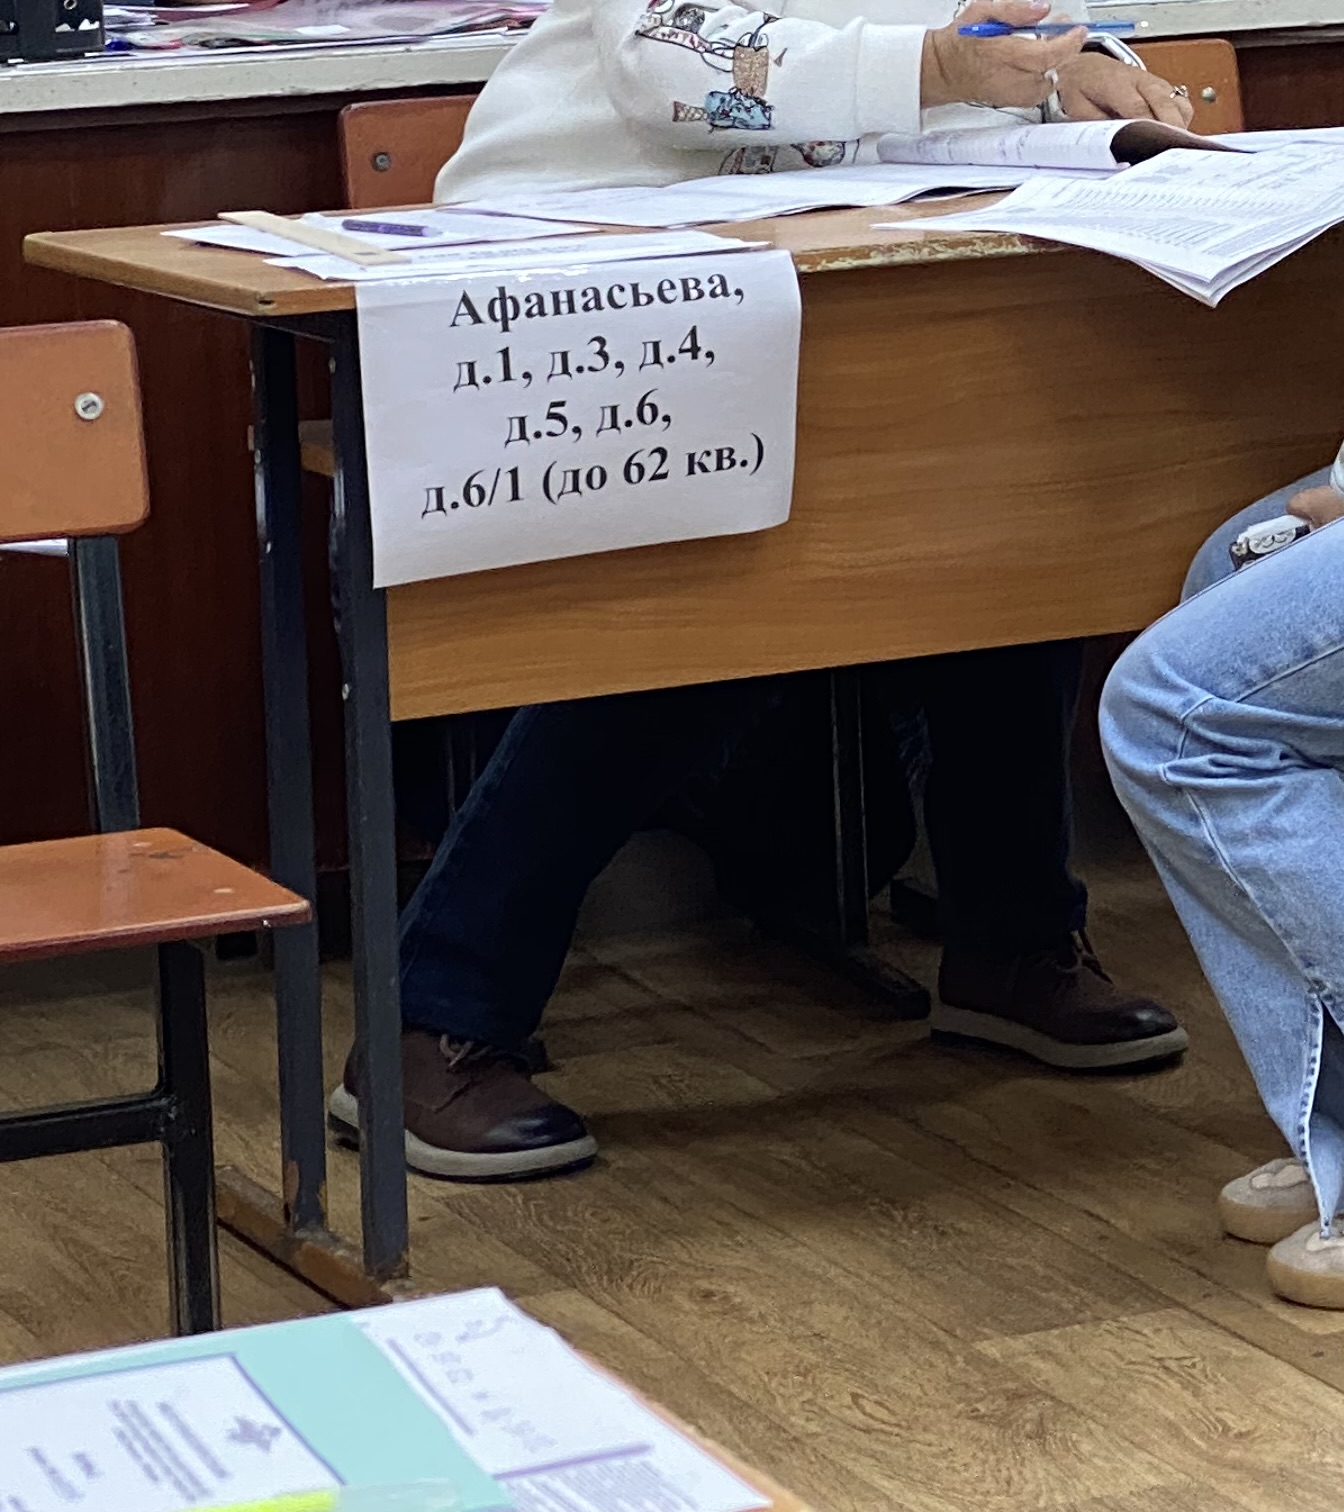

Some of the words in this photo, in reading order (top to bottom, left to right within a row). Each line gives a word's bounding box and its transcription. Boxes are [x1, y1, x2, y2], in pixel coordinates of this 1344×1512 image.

[448, 270, 746, 334] Афанасьева,
[452, 345, 535, 394] д.1,
[546, 333, 626, 382] д.3,
[638, 324, 716, 369] д.4,
[504, 399, 583, 449] д.5,
[596, 388, 673, 437] д.6,
[420, 464, 524, 520] д.6/1
[541, 459, 609, 506] (до
[622, 446, 671, 485] 62
[684, 431, 766, 479] кв.)
